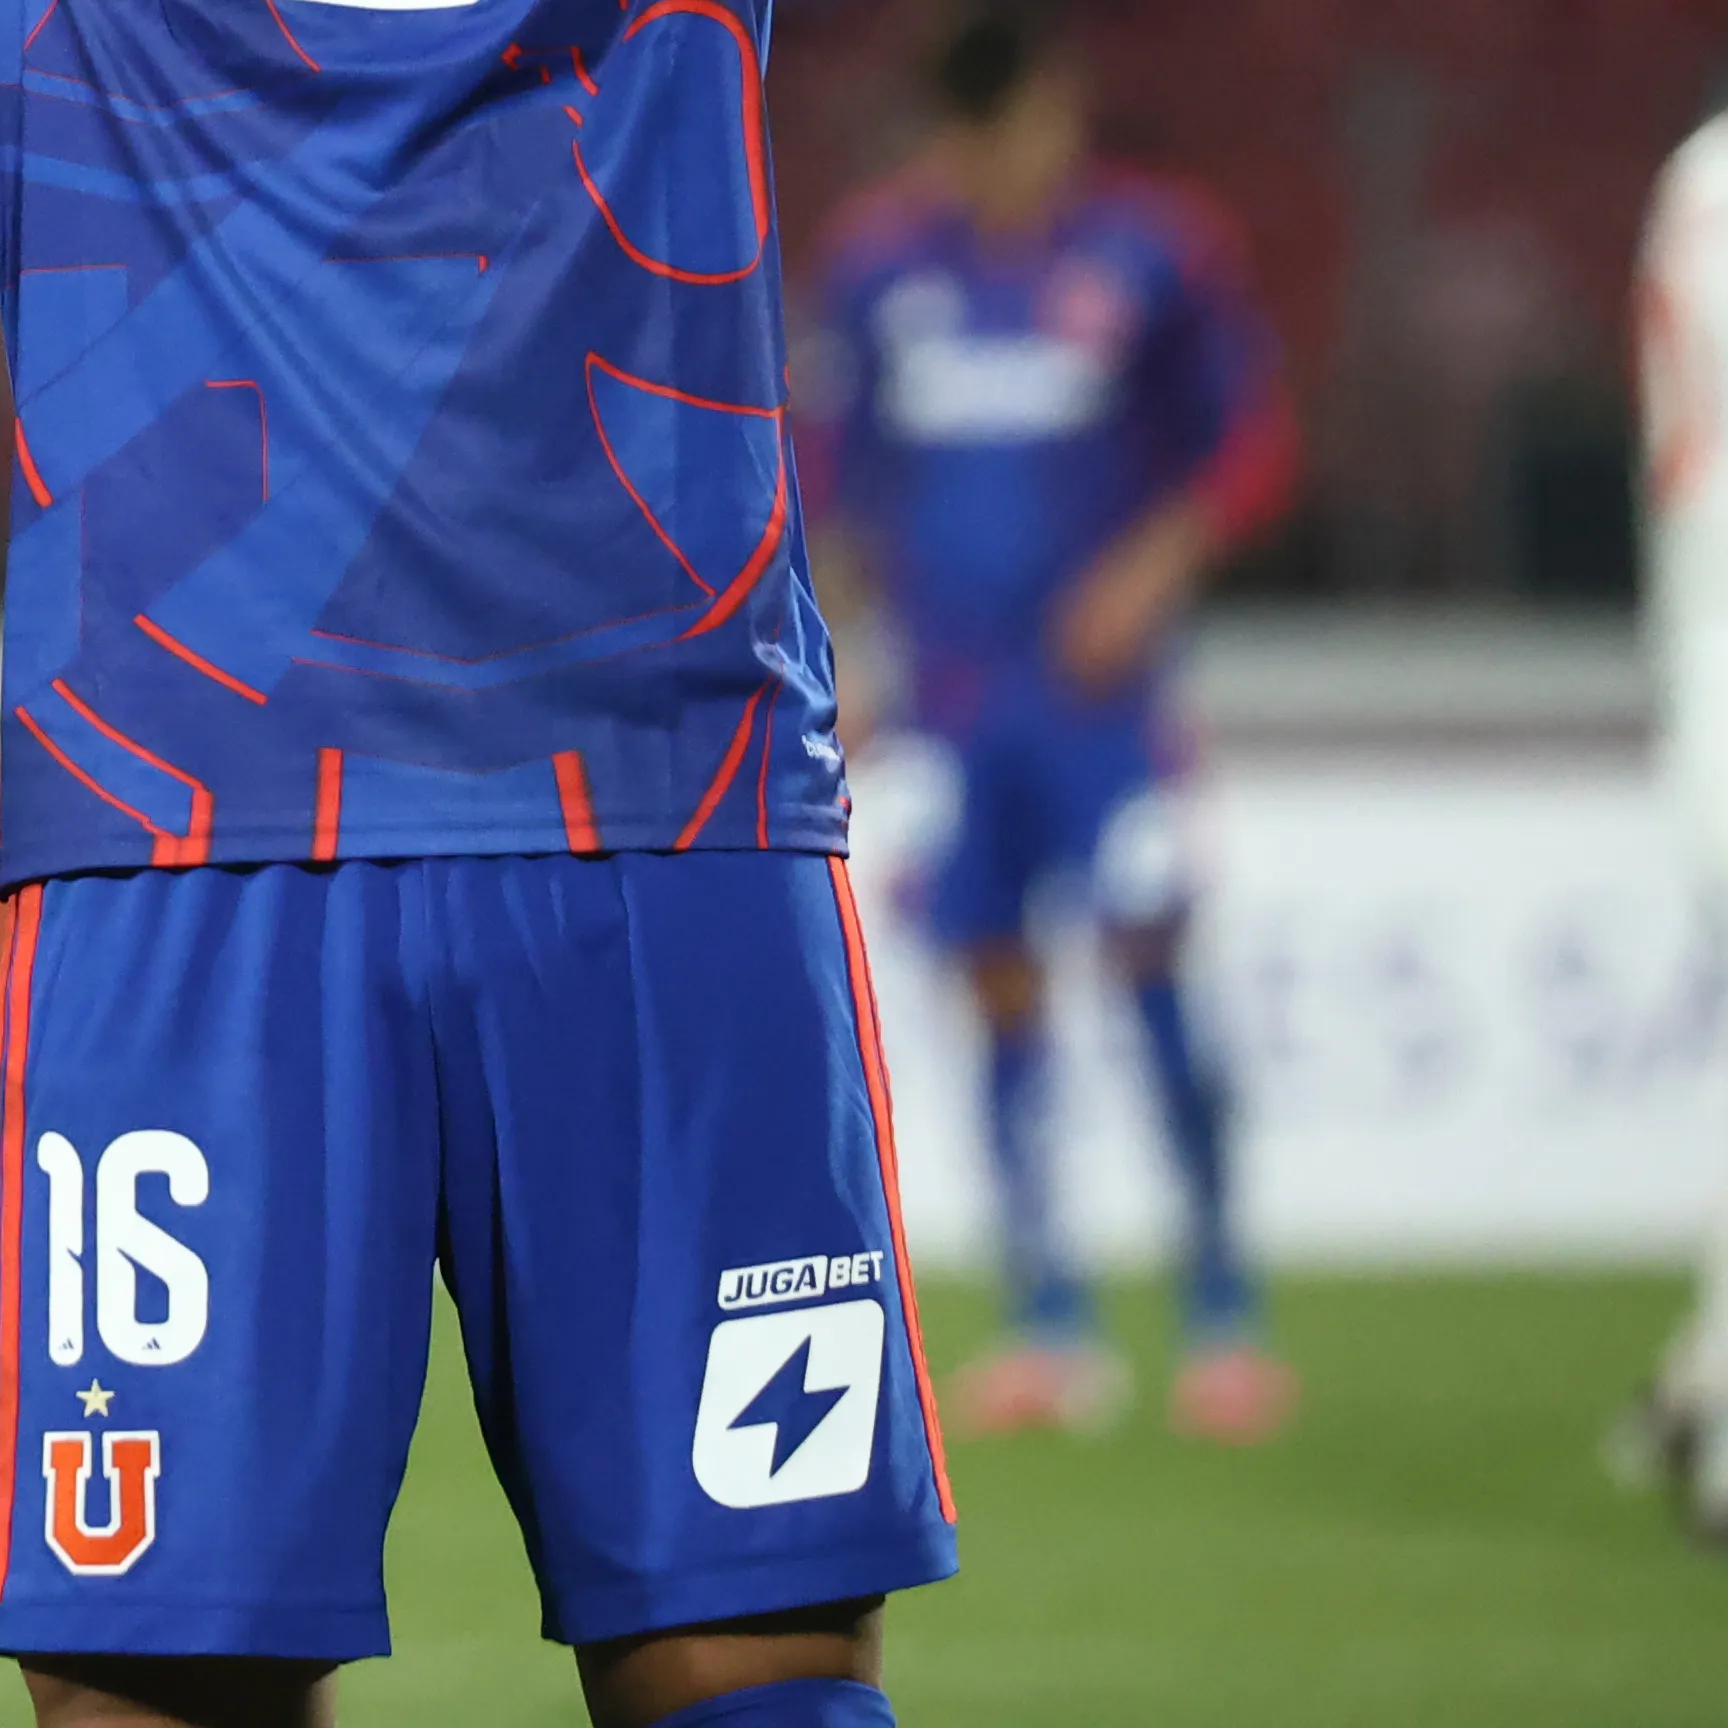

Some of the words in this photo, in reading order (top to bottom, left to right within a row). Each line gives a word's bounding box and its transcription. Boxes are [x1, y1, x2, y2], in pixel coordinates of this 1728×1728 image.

[36, 1129, 209, 1367] 16
[724, 1250, 884, 1303] JUGABET
[42, 1430, 160, 1575] U
